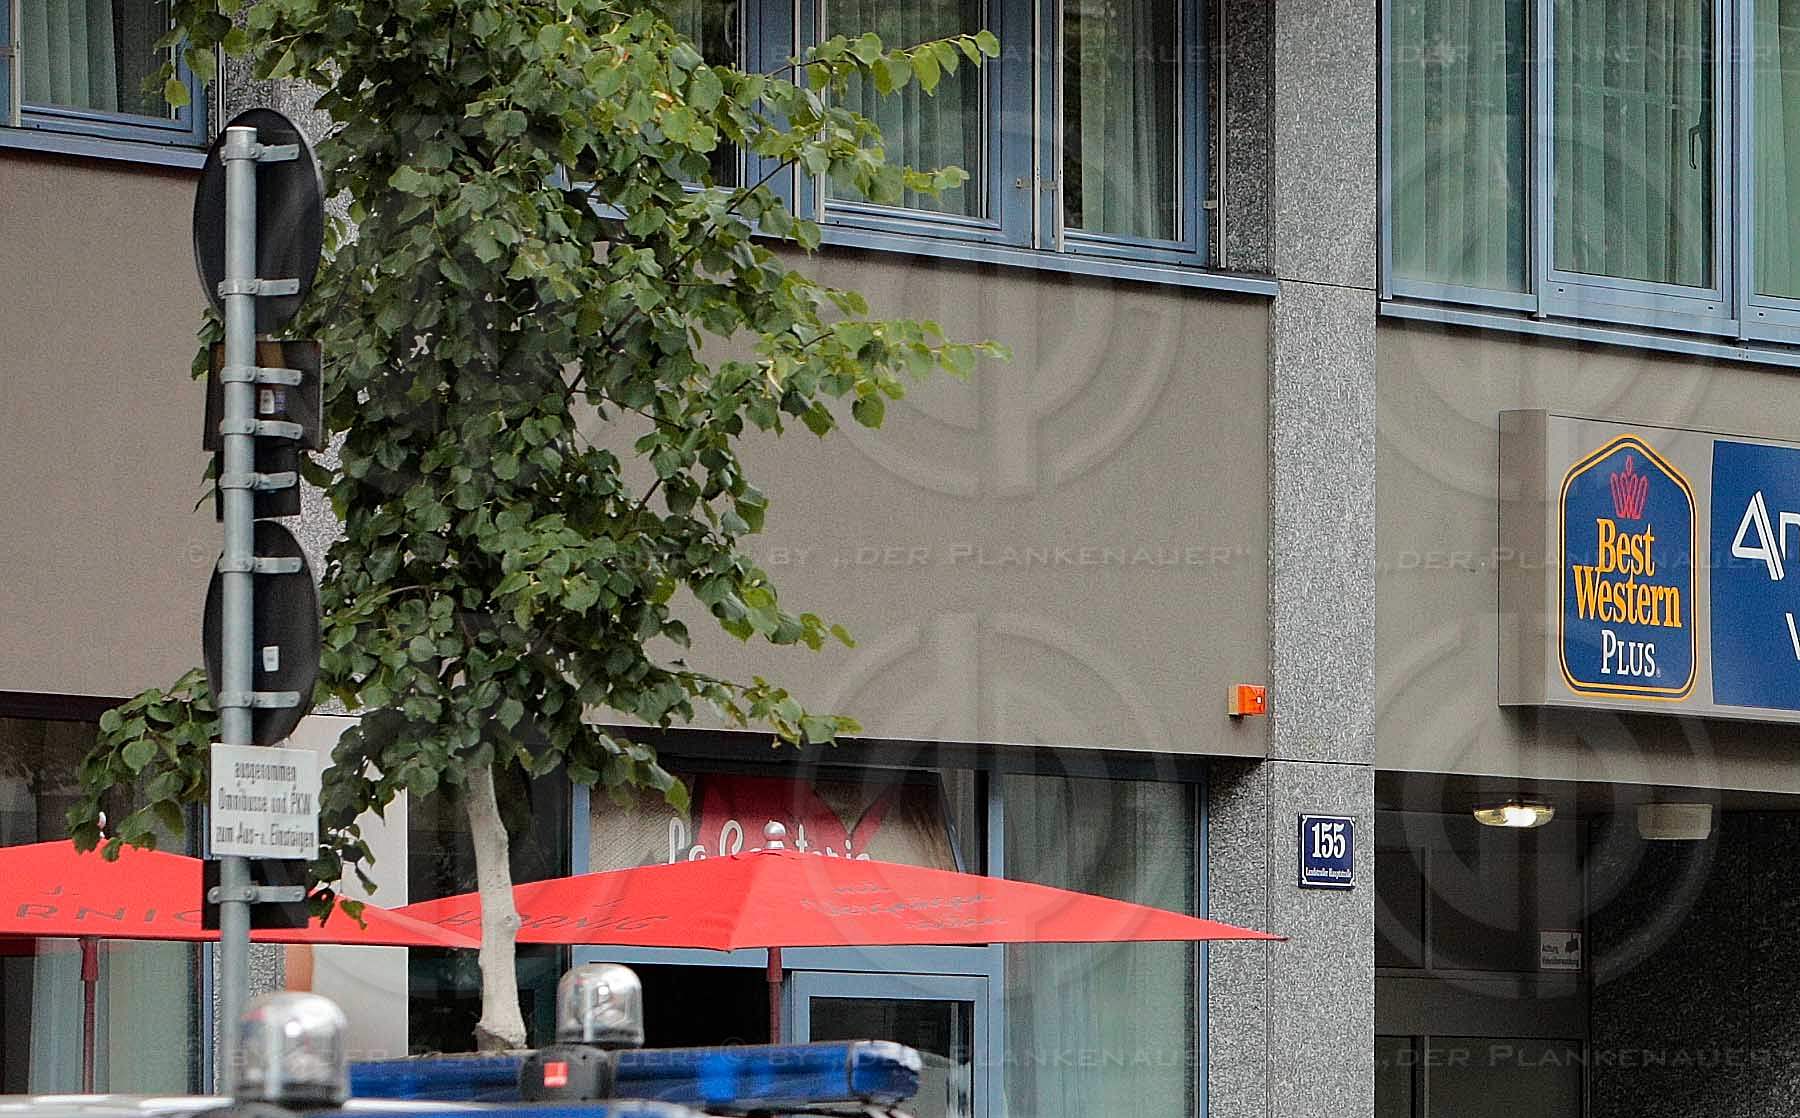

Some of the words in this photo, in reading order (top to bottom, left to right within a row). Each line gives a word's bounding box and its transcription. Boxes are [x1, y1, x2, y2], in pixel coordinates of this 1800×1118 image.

[1596, 518, 1656, 577] Best
[1573, 565, 1682, 629] Western
[1311, 822, 1346, 859] 155
